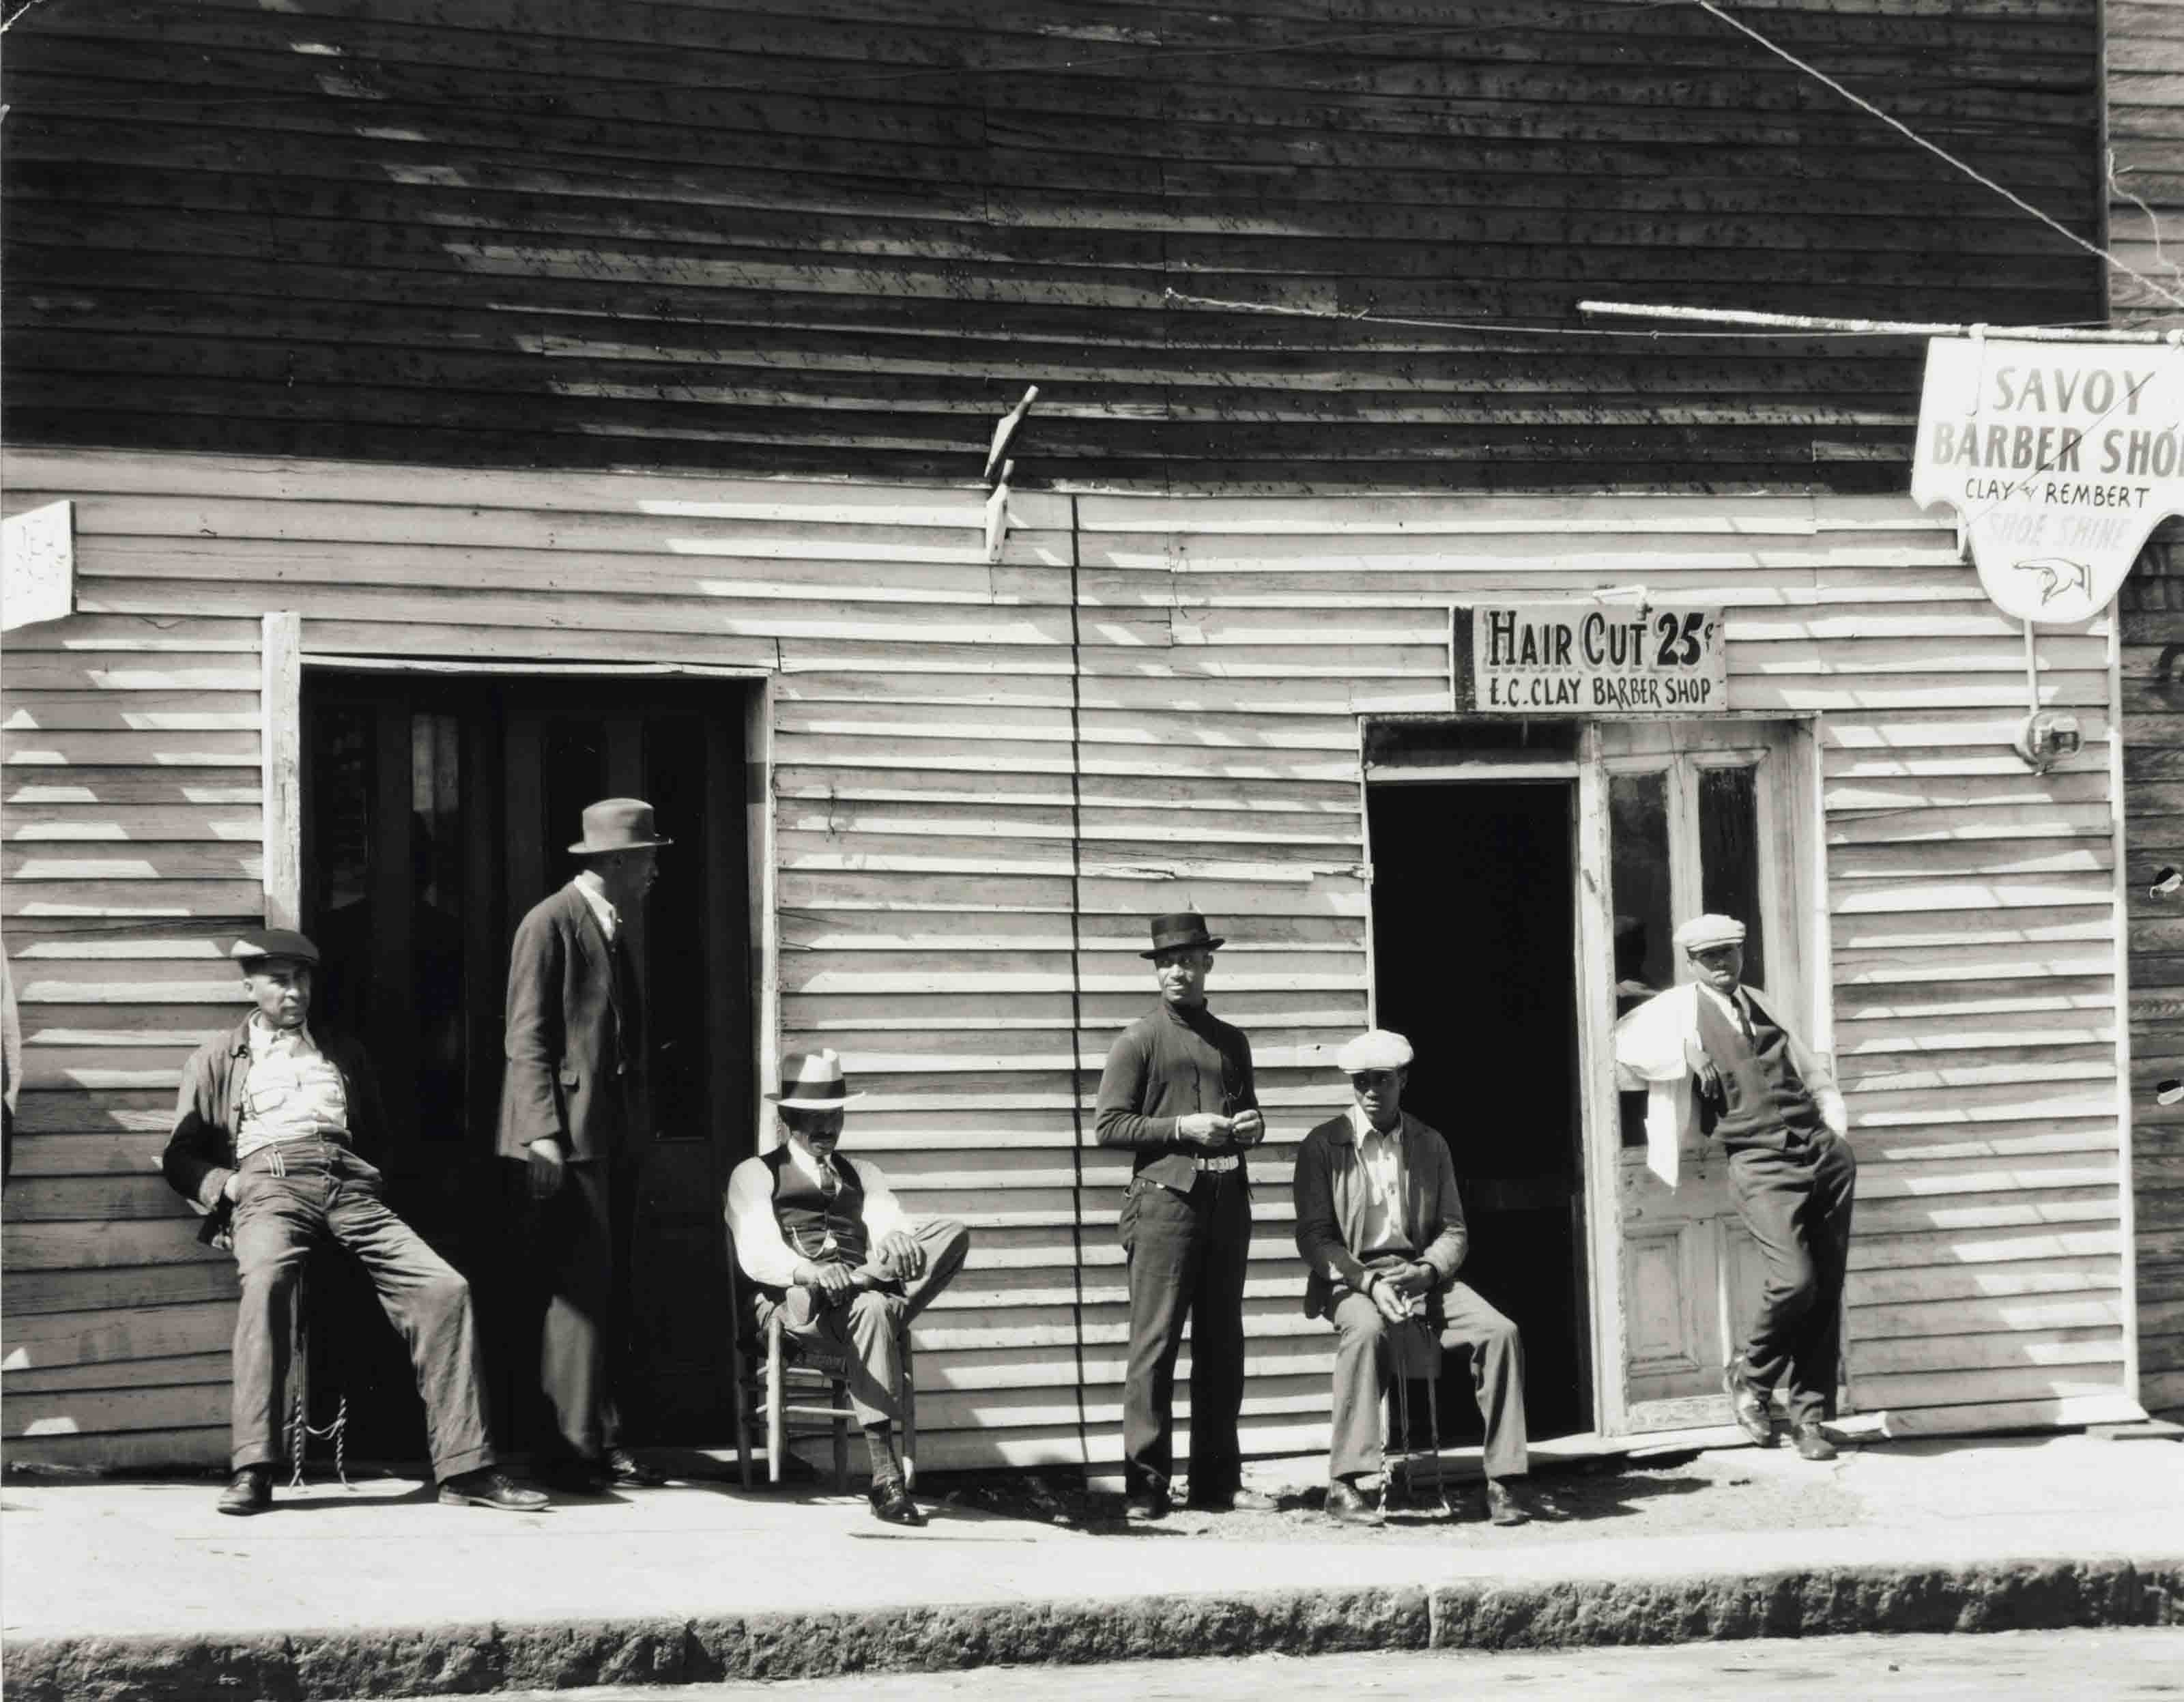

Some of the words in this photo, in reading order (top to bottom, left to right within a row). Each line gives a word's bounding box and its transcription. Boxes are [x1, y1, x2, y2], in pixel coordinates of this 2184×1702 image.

[1992, 367, 2155, 415] SAVOY
[1931, 422, 2082, 472] BARBER
[2100, 428, 2184, 478] SHO
[1966, 478, 2014, 500] CLAY
[2045, 482, 2151, 508] REMBERT
[1987, 512, 2047, 546] SHOE
[2057, 515, 2132, 550] SHINE
[1489, 611, 1572, 666] HAIR
[1584, 612, 1648, 665] CUT
[1592, 677, 1663, 710] BARBER
[1666, 678, 1711, 704] SHOP
